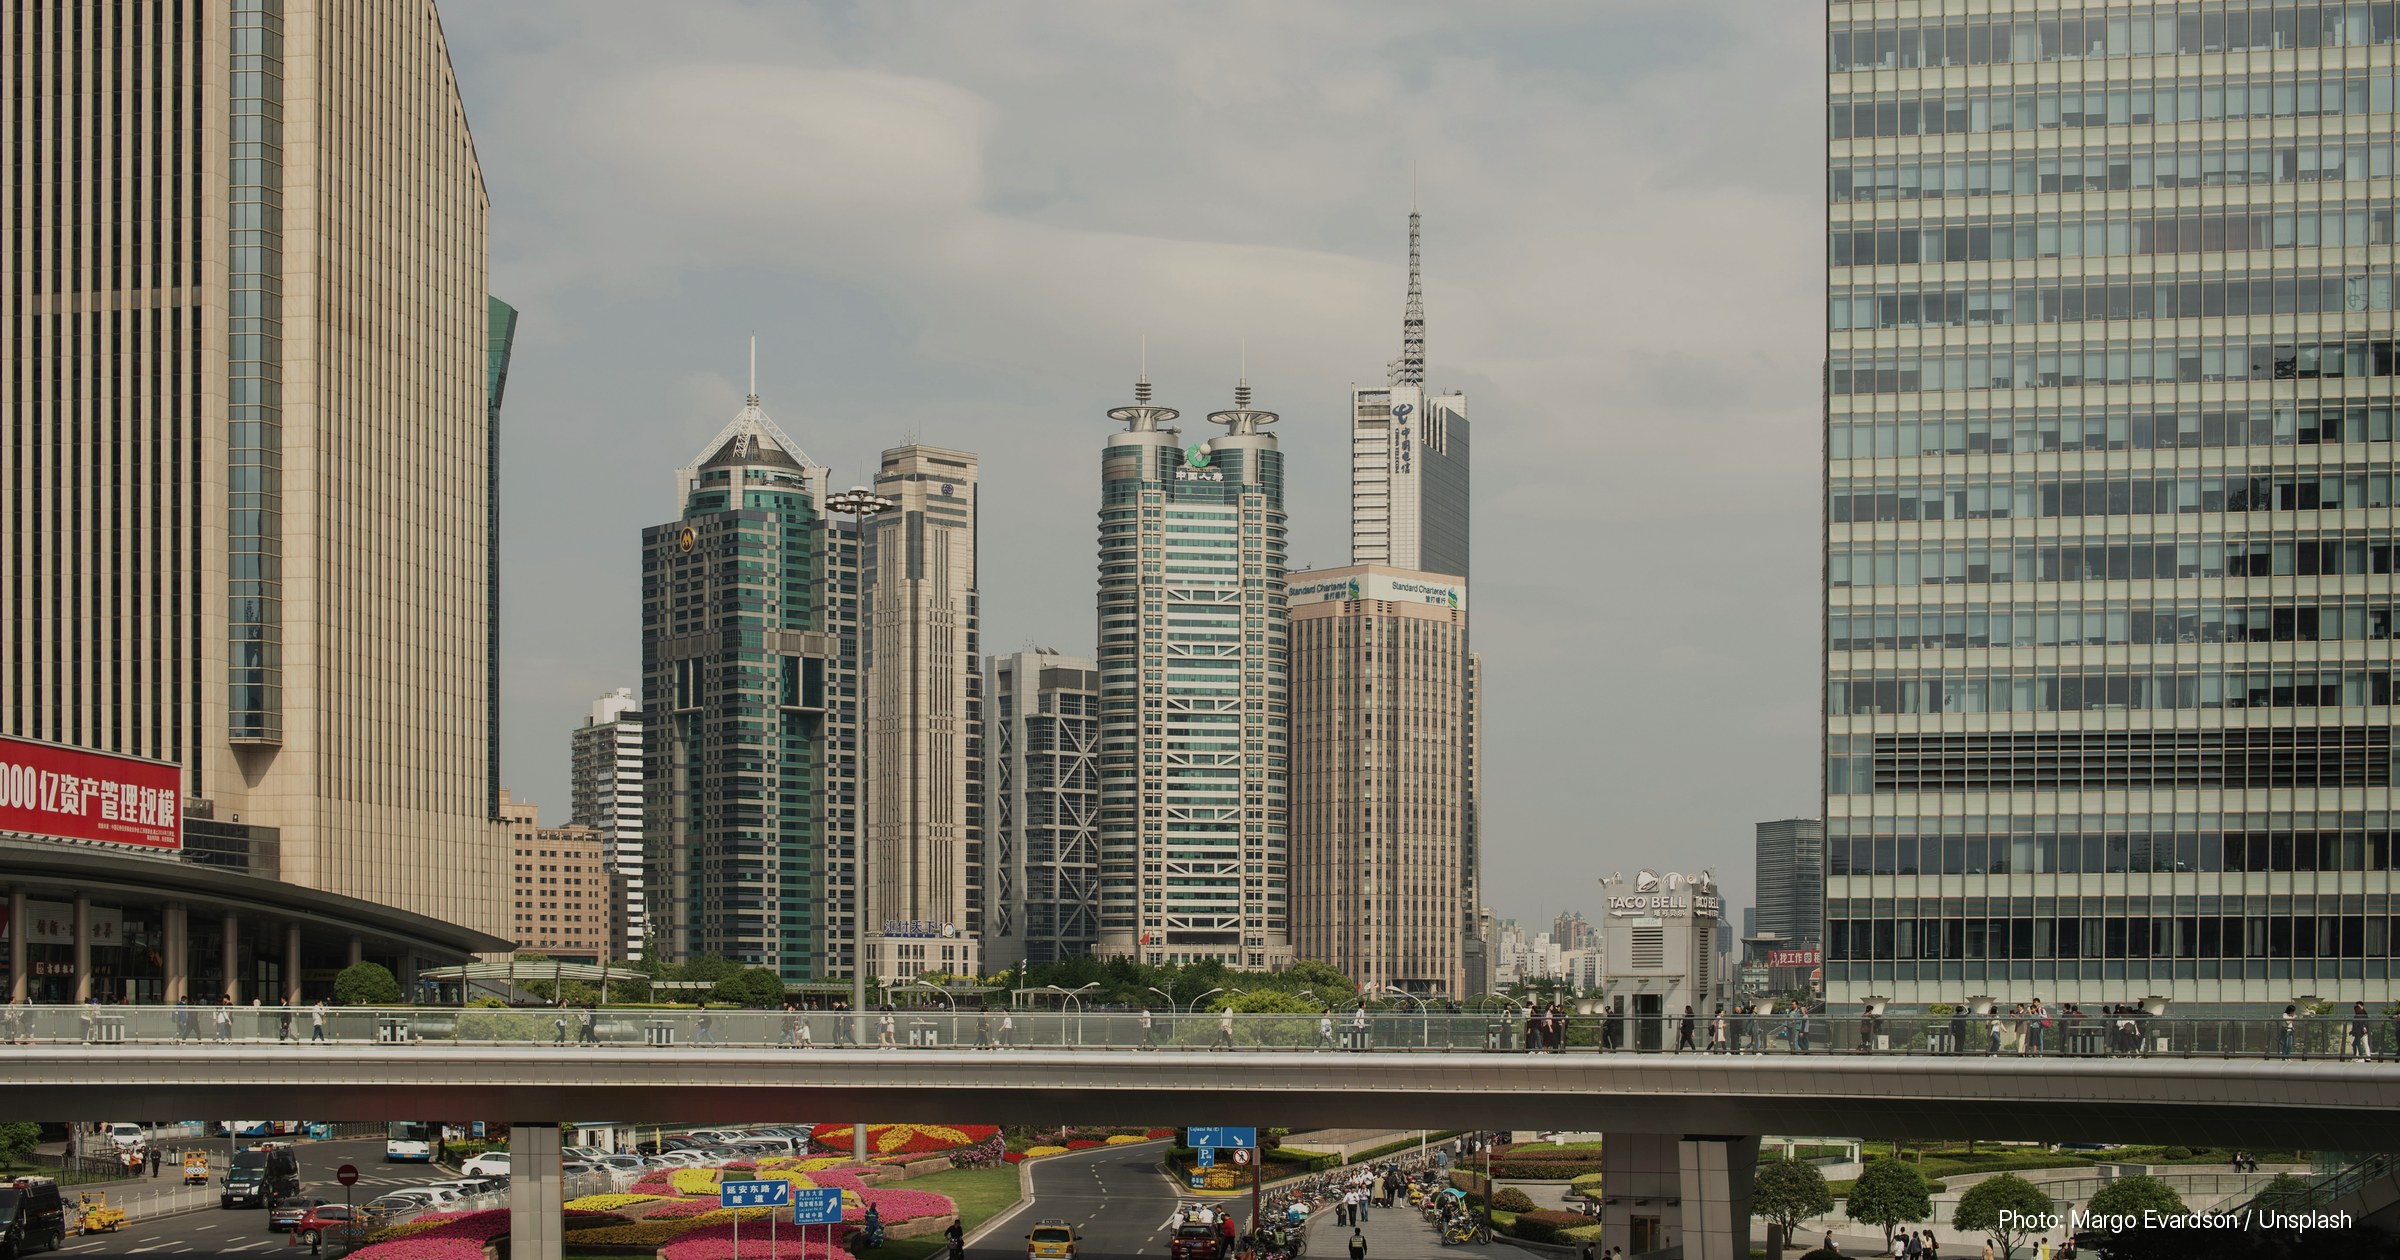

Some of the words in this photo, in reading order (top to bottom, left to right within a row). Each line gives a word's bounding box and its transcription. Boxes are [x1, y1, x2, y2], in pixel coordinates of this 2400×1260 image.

[1401, 427, 1411, 474] 中国电信
[1176, 471, 1223, 482] 中国人寿
[1289, 585, 1315, 596] Standard
[1317, 580, 1347, 593] Chartered
[1392, 581, 1418, 593] Standard
[1419, 585, 1447, 596] Chartered
[1608, 896, 1647, 909] TACO
[1651, 896, 1687, 909] BELL
[1694, 896, 1708, 908] TACO
[1708, 897, 1719, 909] BELL
[885, 920, 936, 933] 汇付天下
[726, 1185, 771, 1195] 延安东路
[732, 1195, 764, 1204] 隧道
